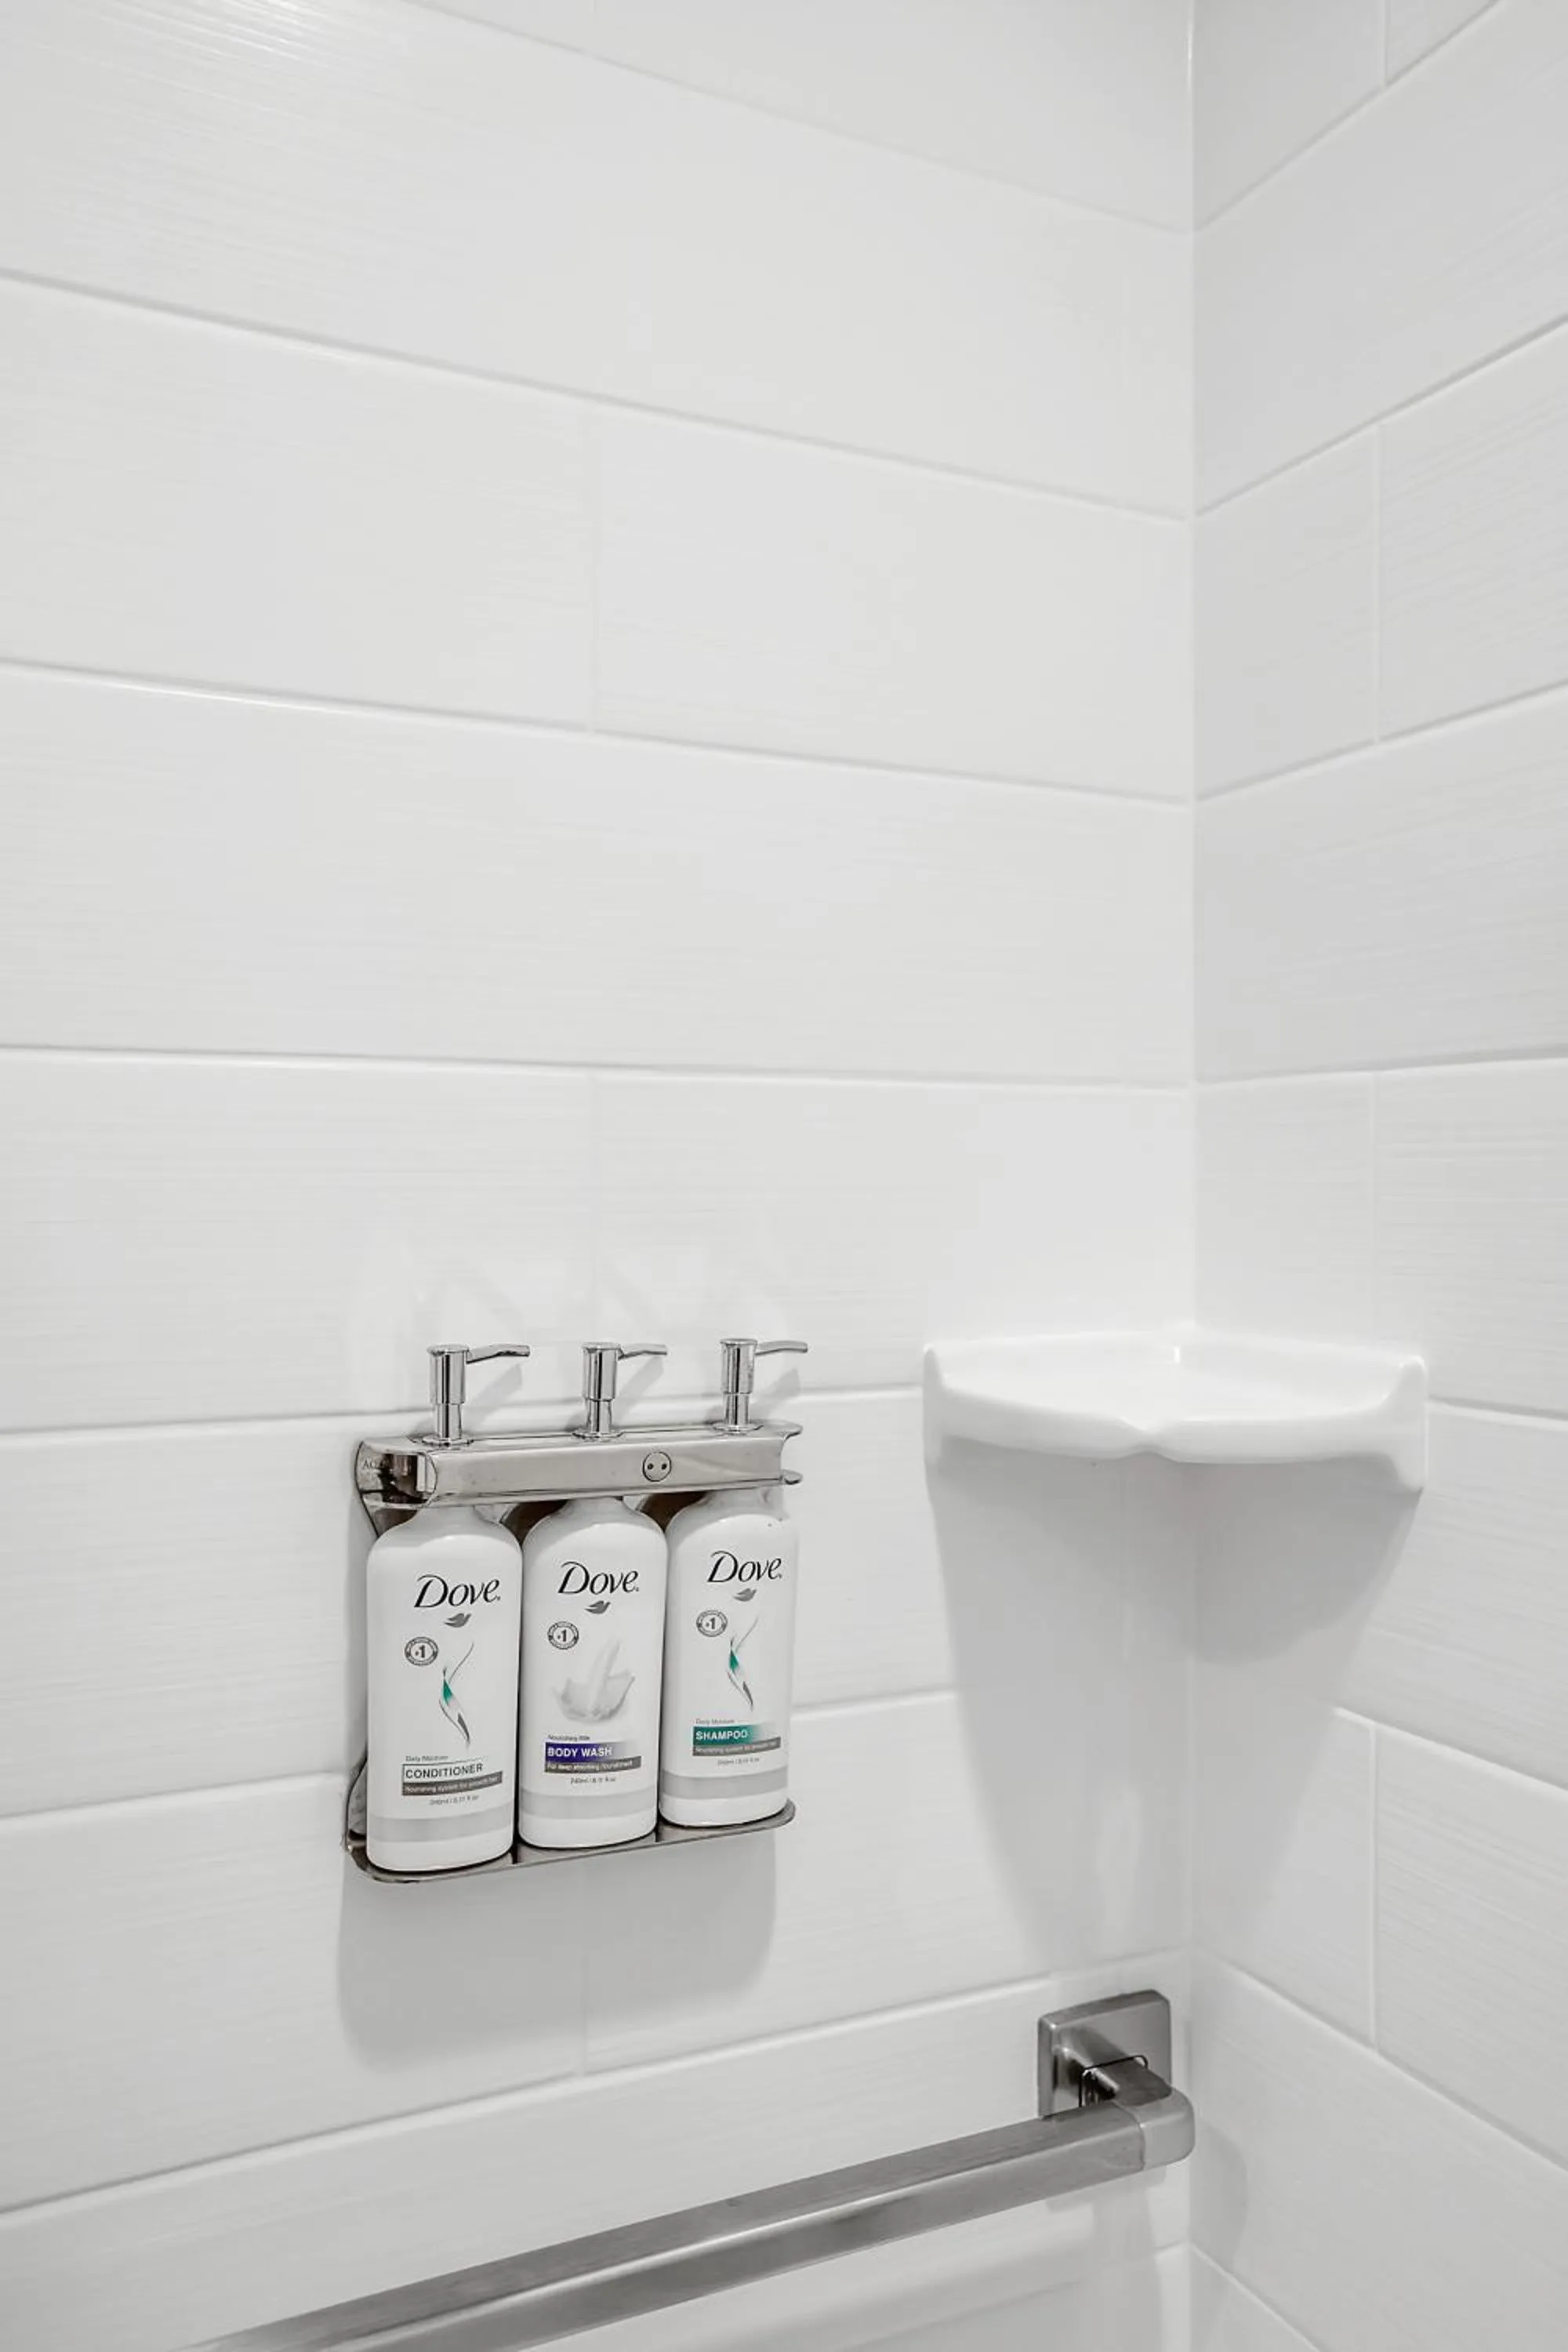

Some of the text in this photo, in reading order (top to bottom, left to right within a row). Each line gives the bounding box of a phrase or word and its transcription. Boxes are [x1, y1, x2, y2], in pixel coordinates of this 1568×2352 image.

[557, 1560, 639, 1595] Dove
[706, 1550, 782, 1583] Dove
[413, 1573, 500, 1608] Dove
[695, 1730, 748, 1740] SHAMPOO
[547, 1747, 612, 1757] BODY WASH
[405, 1763, 483, 1779] CONDITIONER
